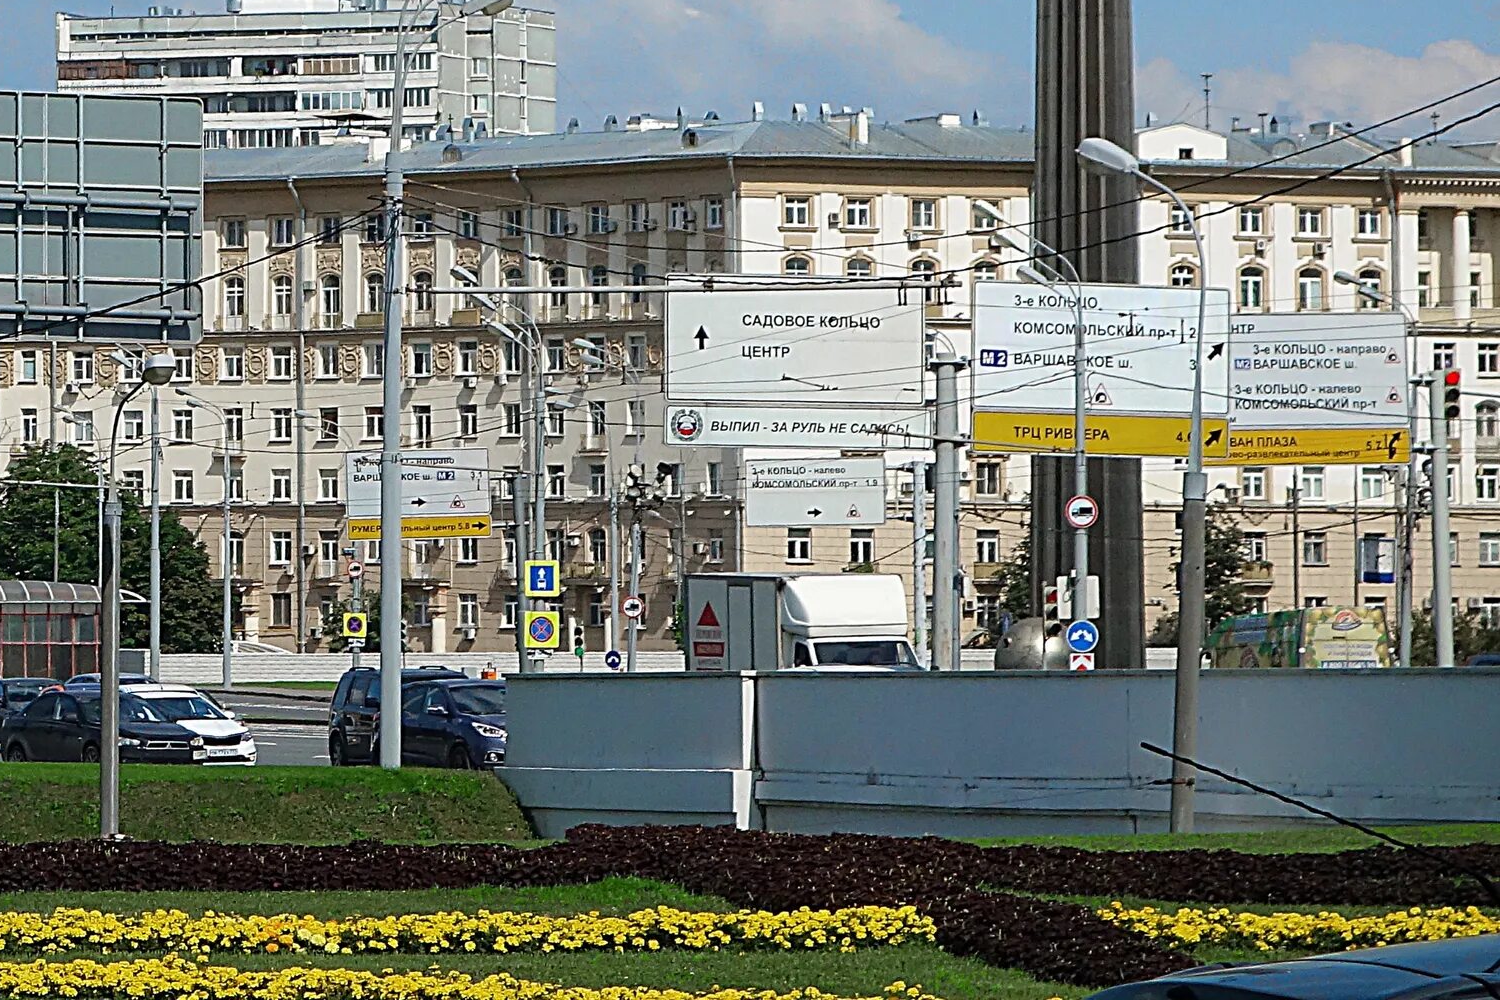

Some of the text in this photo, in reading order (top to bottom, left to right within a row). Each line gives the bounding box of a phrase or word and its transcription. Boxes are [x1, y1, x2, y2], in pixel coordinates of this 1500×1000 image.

[1014, 294, 1034, 307] 3-е
[742, 314, 881, 330] САДОВОЕ КОЛЬЦО
[1149, 328, 1176, 340] пр-т
[741, 345, 791, 359] ЦЕНТР
[1253, 344, 1270, 354] 3-е
[1274, 343, 1326, 356] КОЛЬЦО
[1336, 345, 1387, 356] направо
[1014, 353, 1114, 368] ВАРШАВКОЕ
[1118, 358, 1133, 369] ш.
[1253, 358, 1341, 370] ВАРШАВСКОЕ
[1344, 361, 1358, 369] ш.
[1235, 384, 1252, 394] 3-е
[1256, 383, 1308, 396] КОЛЬЦО
[1318, 385, 1362, 394] налево
[1235, 397, 1377, 411] КОМСОМОЛЬСКИЙ пр-т
[710, 420, 760, 433] ВЫПИЛ
[771, 421, 790, 433] ЗА
[792, 422, 826, 433] РУЛЬ
[829, 423, 847, 434] НЕ
[1014, 426, 1041, 441] ТРЦ
[1045, 427, 1110, 441] РИВЕРА
[1256, 436, 1297, 447] ПЛАЗА
[1333, 449, 1361, 458] центр
[767, 466, 807, 476] КОЛЬЦО
[814, 466, 846, 474] налево
[752, 478, 837, 488] КОМСОМОЛЬСКИЙ
[432, 523, 456, 532] центр
